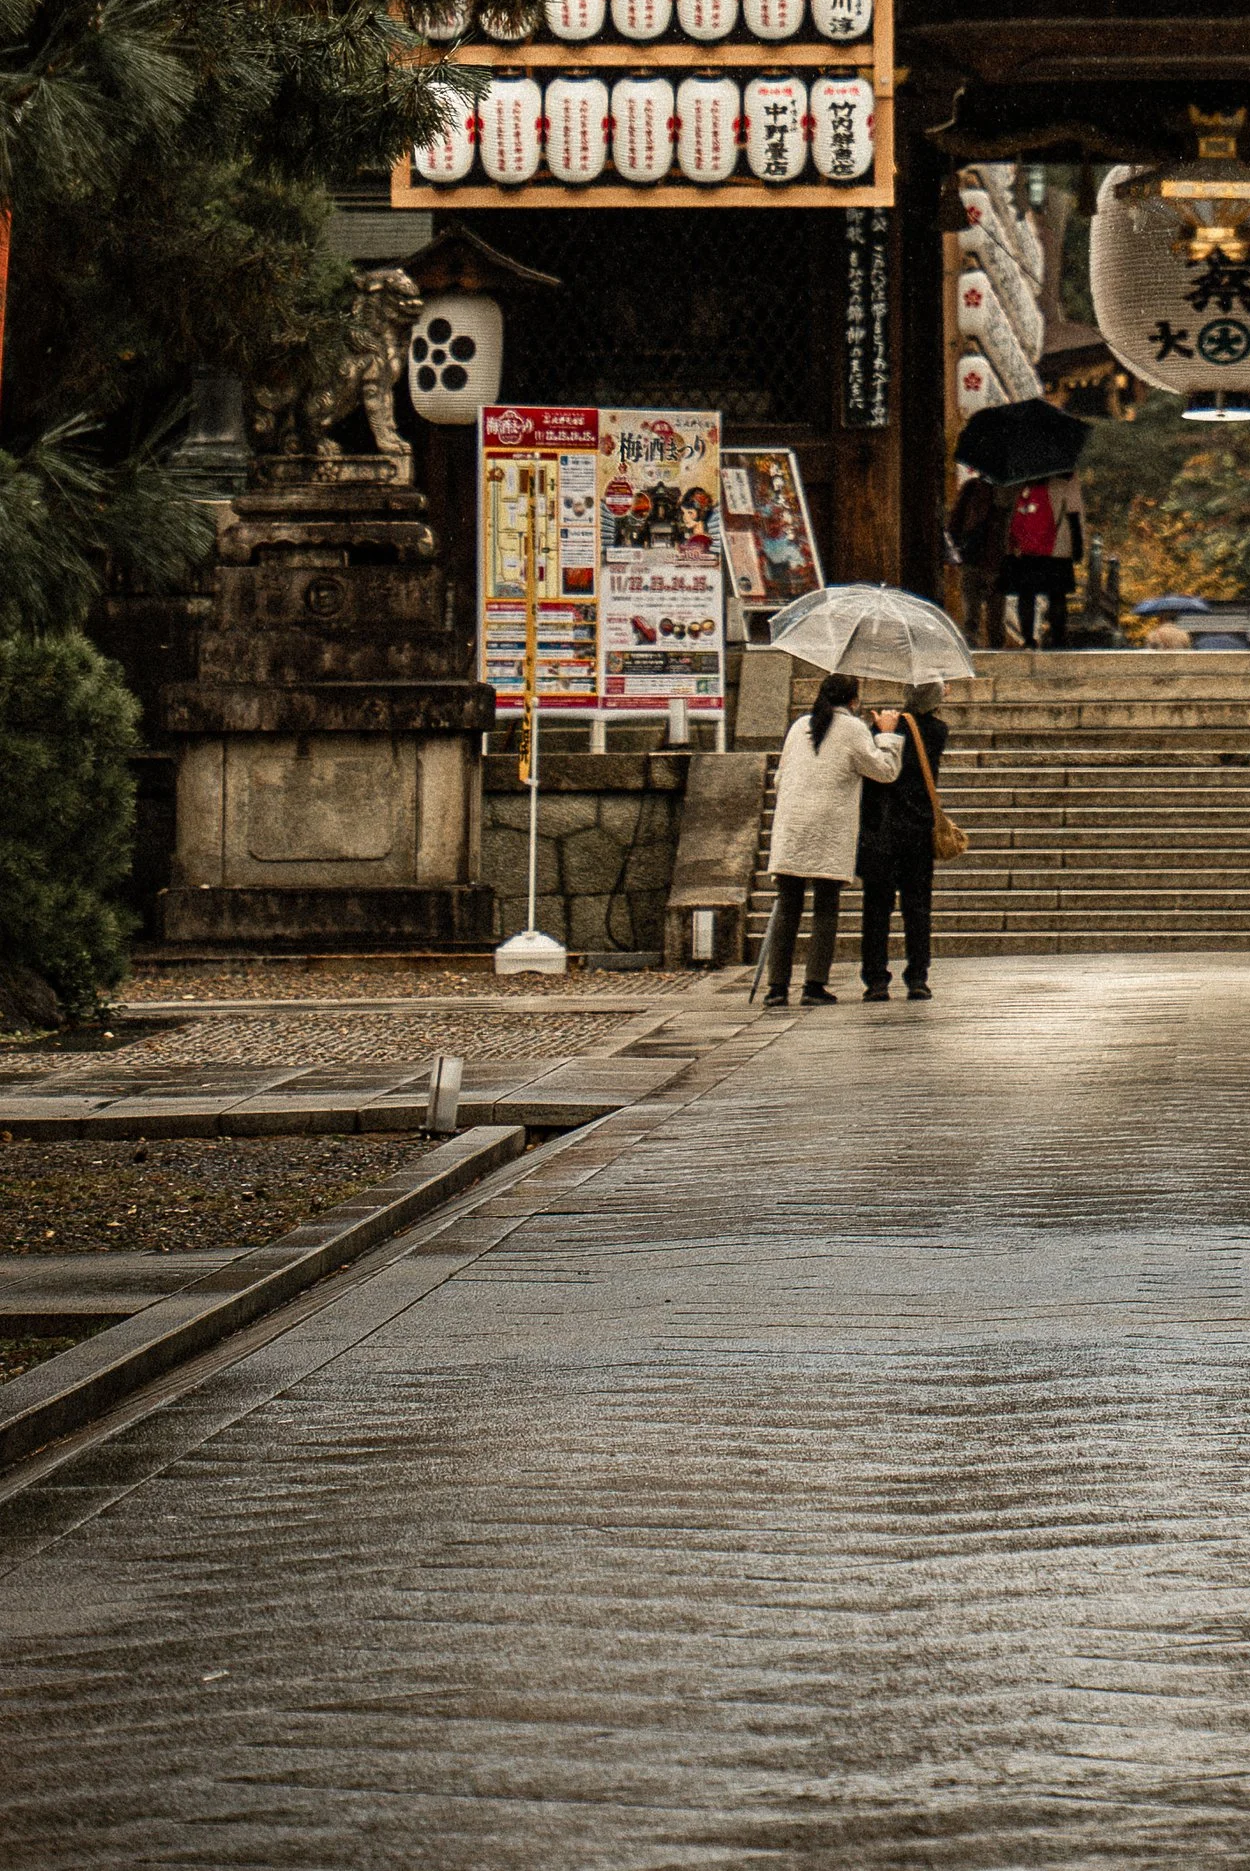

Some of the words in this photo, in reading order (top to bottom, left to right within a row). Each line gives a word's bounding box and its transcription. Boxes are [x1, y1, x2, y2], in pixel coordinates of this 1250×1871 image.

[620, 432, 706, 463] 梅酒まつり
